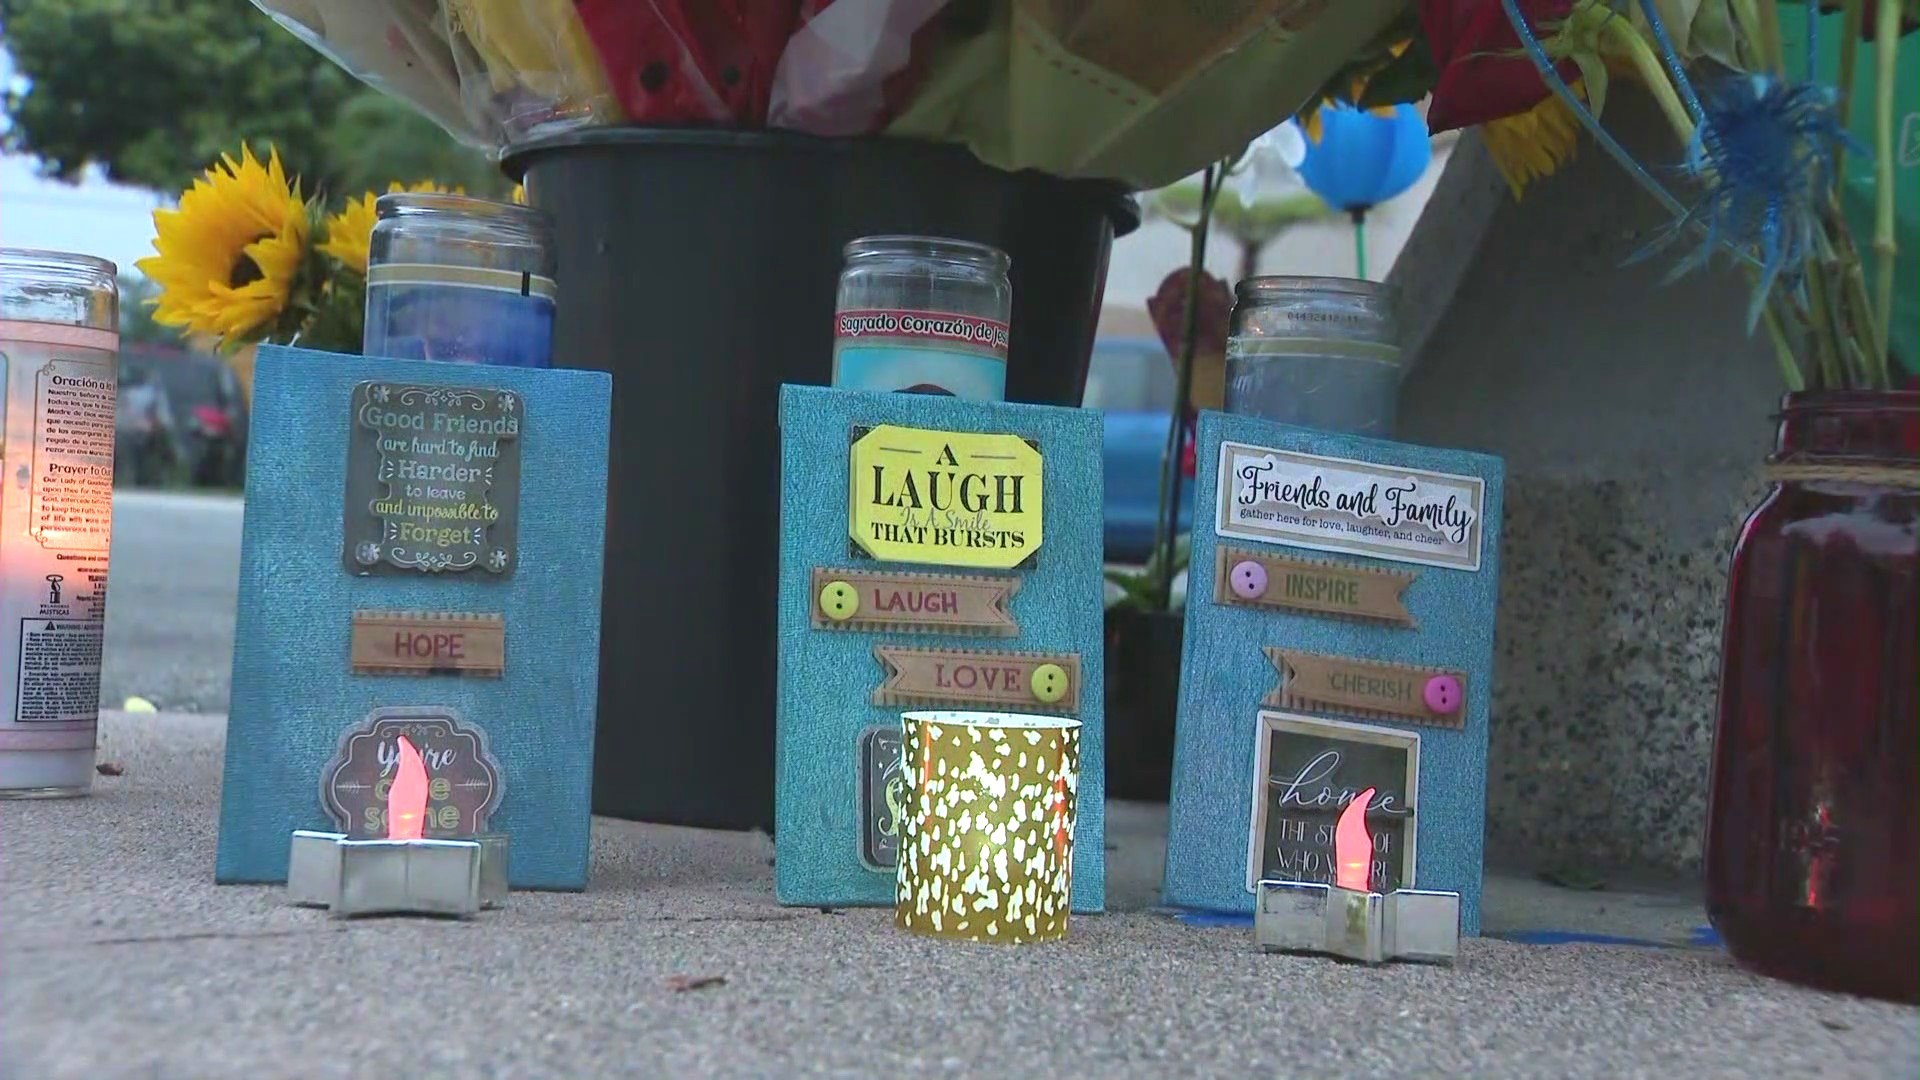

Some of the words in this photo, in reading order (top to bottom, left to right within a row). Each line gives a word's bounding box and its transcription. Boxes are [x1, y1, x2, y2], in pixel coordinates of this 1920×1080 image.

[841, 315, 896, 335] Sagrado
[900, 316, 972, 340] Corazón
[975, 323, 992, 339] de
[52, 375, 98, 389] Oración
[100, 382, 105, 390] a
[366, 406, 424, 430] Good
[432, 412, 519, 435] Friends
[384, 438, 409, 451] are
[411, 437, 447, 455] hard
[450, 440, 465, 456] to
[465, 440, 499, 462] find
[936, 443, 959, 467] A
[49, 463, 88, 476] Prayer
[90, 466, 100, 475] to
[398, 460, 481, 483] Harder
[406, 484, 422, 497] to
[426, 485, 466, 501] leave
[872, 465, 1024, 514] LAUGH
[375, 500, 405, 515] and
[407, 500, 481, 523] impossible
[482, 504, 499, 521] to
[1237, 461, 1330, 508] Friends
[1335, 483, 1378, 518] and
[1381, 482, 1474, 544] Family
[900, 506, 918, 528] Is
[924, 508, 940, 528] A
[945, 508, 991, 531] Smile
[1240, 507, 1276, 522] gather
[1276, 511, 1300, 525] here
[1301, 514, 1318, 527] for
[1319, 518, 1344, 532] love,
[1346, 521, 1392, 540] laughter,
[1393, 530, 1413, 542] and
[1414, 532, 1444, 545] cheer
[399, 522, 473, 547] Forget
[871, 522, 928, 545] THAT
[934, 529, 1025, 549] BURSTS
[873, 588, 958, 614] LAUGH
[1285, 573, 1360, 606] INSPIRE
[394, 632, 465, 659] HOPE
[935, 664, 1021, 692] LOVE
[1330, 673, 1412, 700] CHERISH
[1276, 847, 1319, 872] WHO
